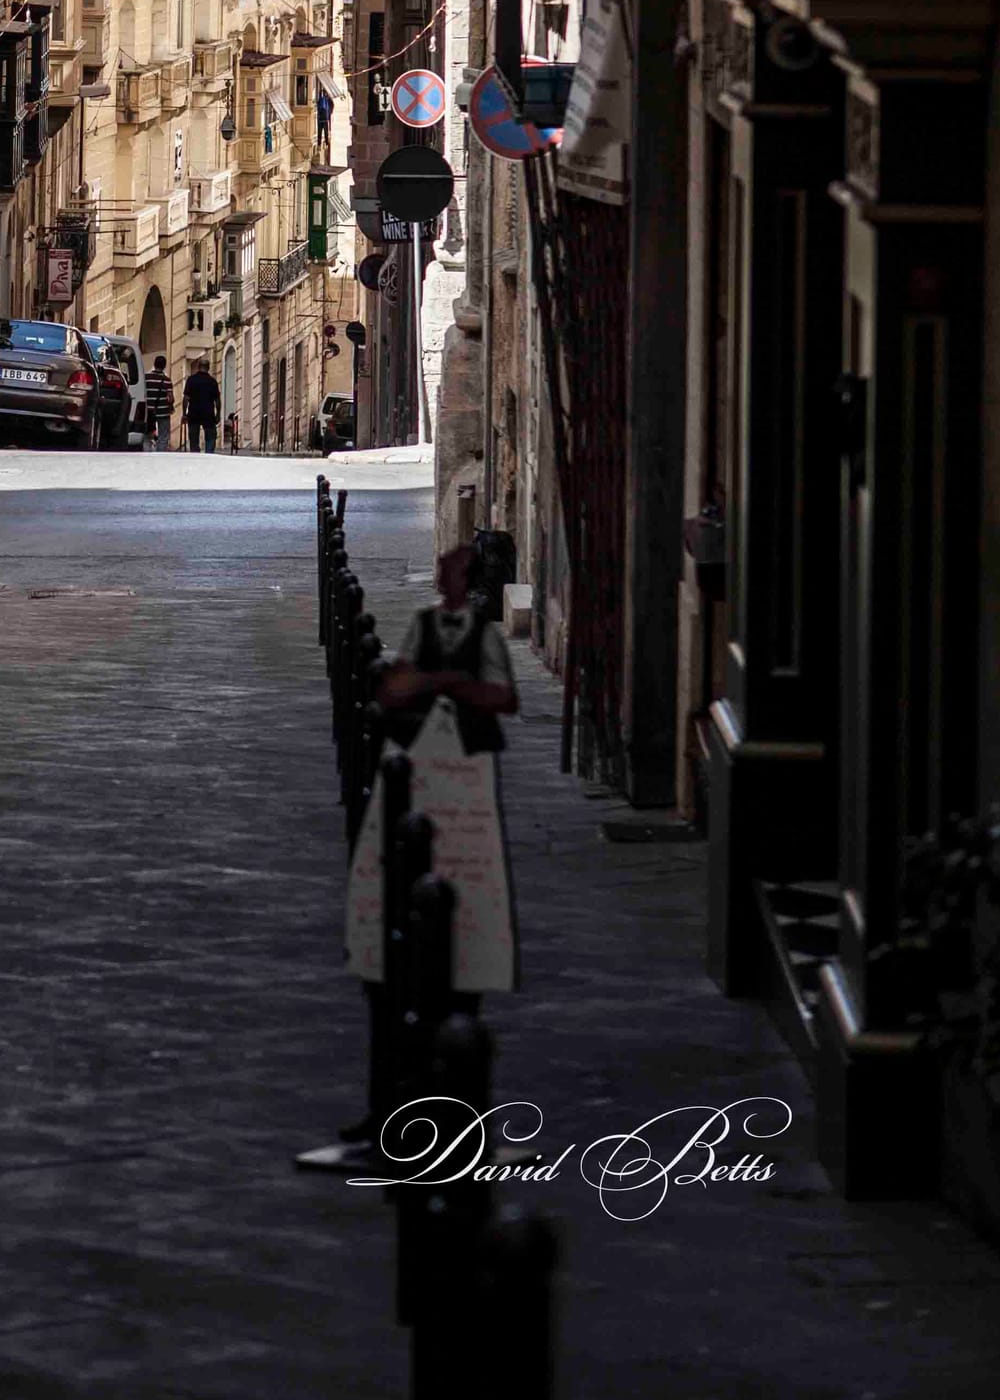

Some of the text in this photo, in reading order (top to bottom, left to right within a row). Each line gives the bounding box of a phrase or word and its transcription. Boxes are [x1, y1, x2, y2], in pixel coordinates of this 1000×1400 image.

[382, 221, 407, 240] WINE
[50, 260, 69, 295] Diva
[25, 371, 46, 381] 649
